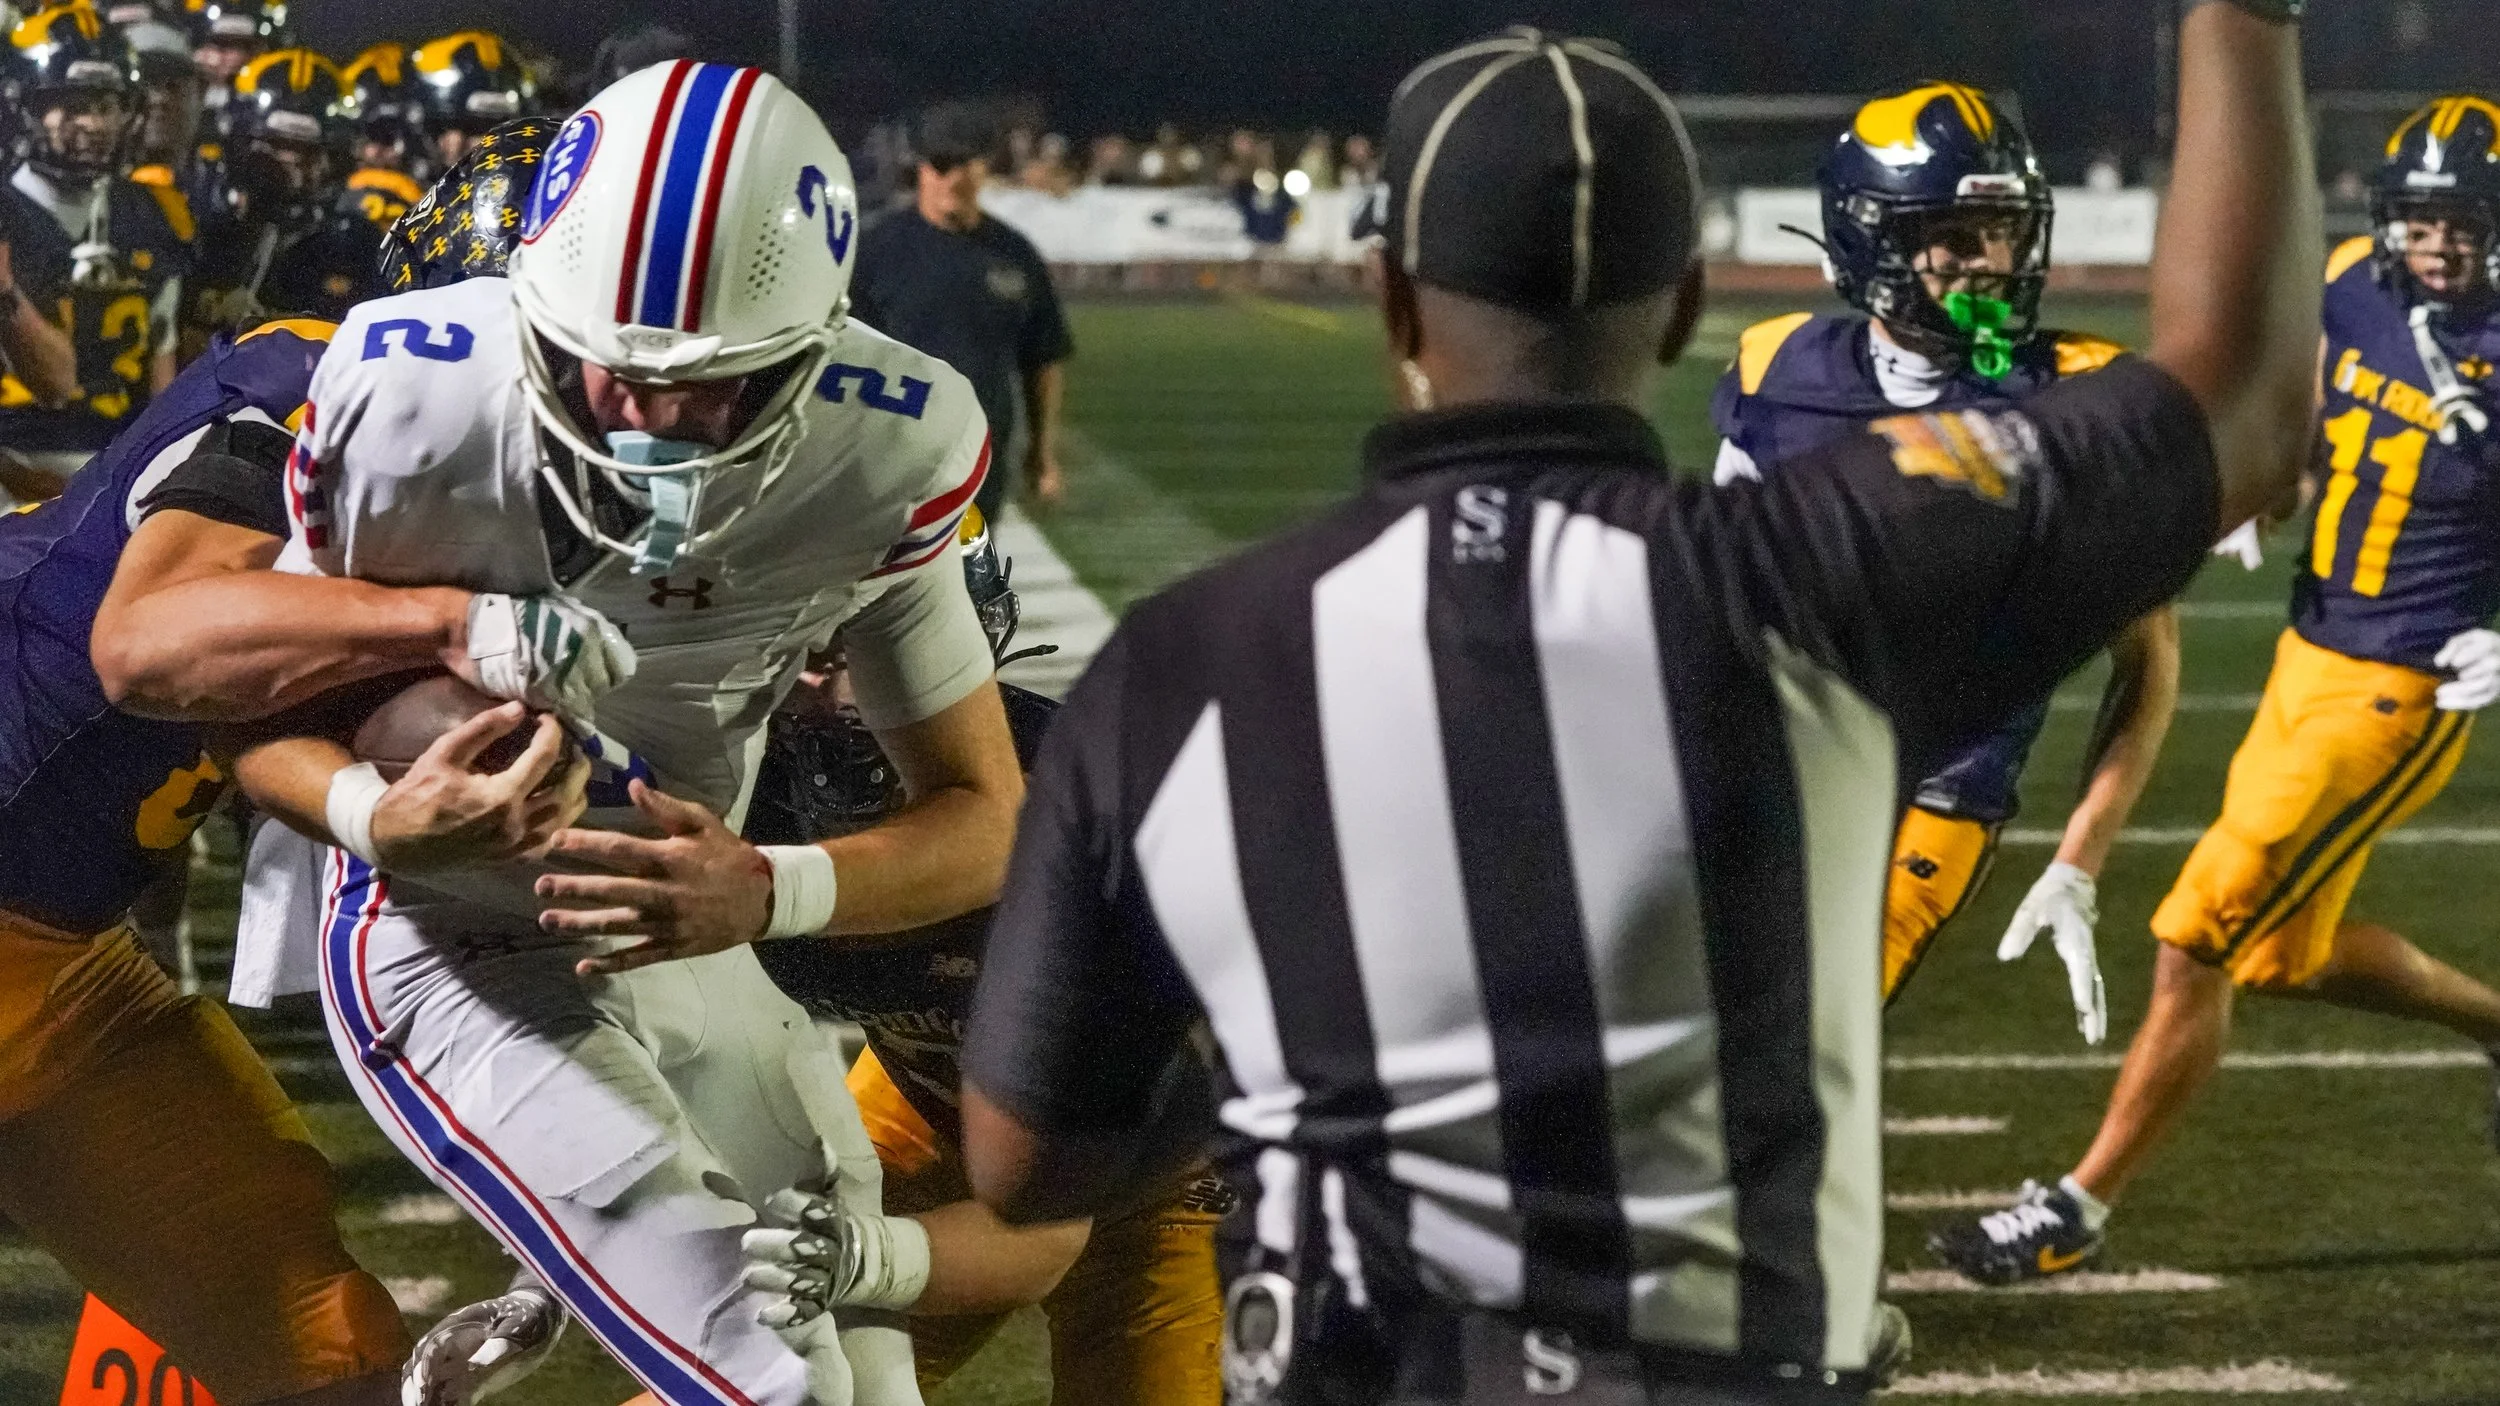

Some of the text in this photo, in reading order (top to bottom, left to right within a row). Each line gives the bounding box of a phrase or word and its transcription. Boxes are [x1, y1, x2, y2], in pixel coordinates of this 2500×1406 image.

[795, 164, 853, 267] 2
[361, 318, 474, 363] 2
[818, 362, 933, 421] 2
[2313, 406, 2428, 598] 11
